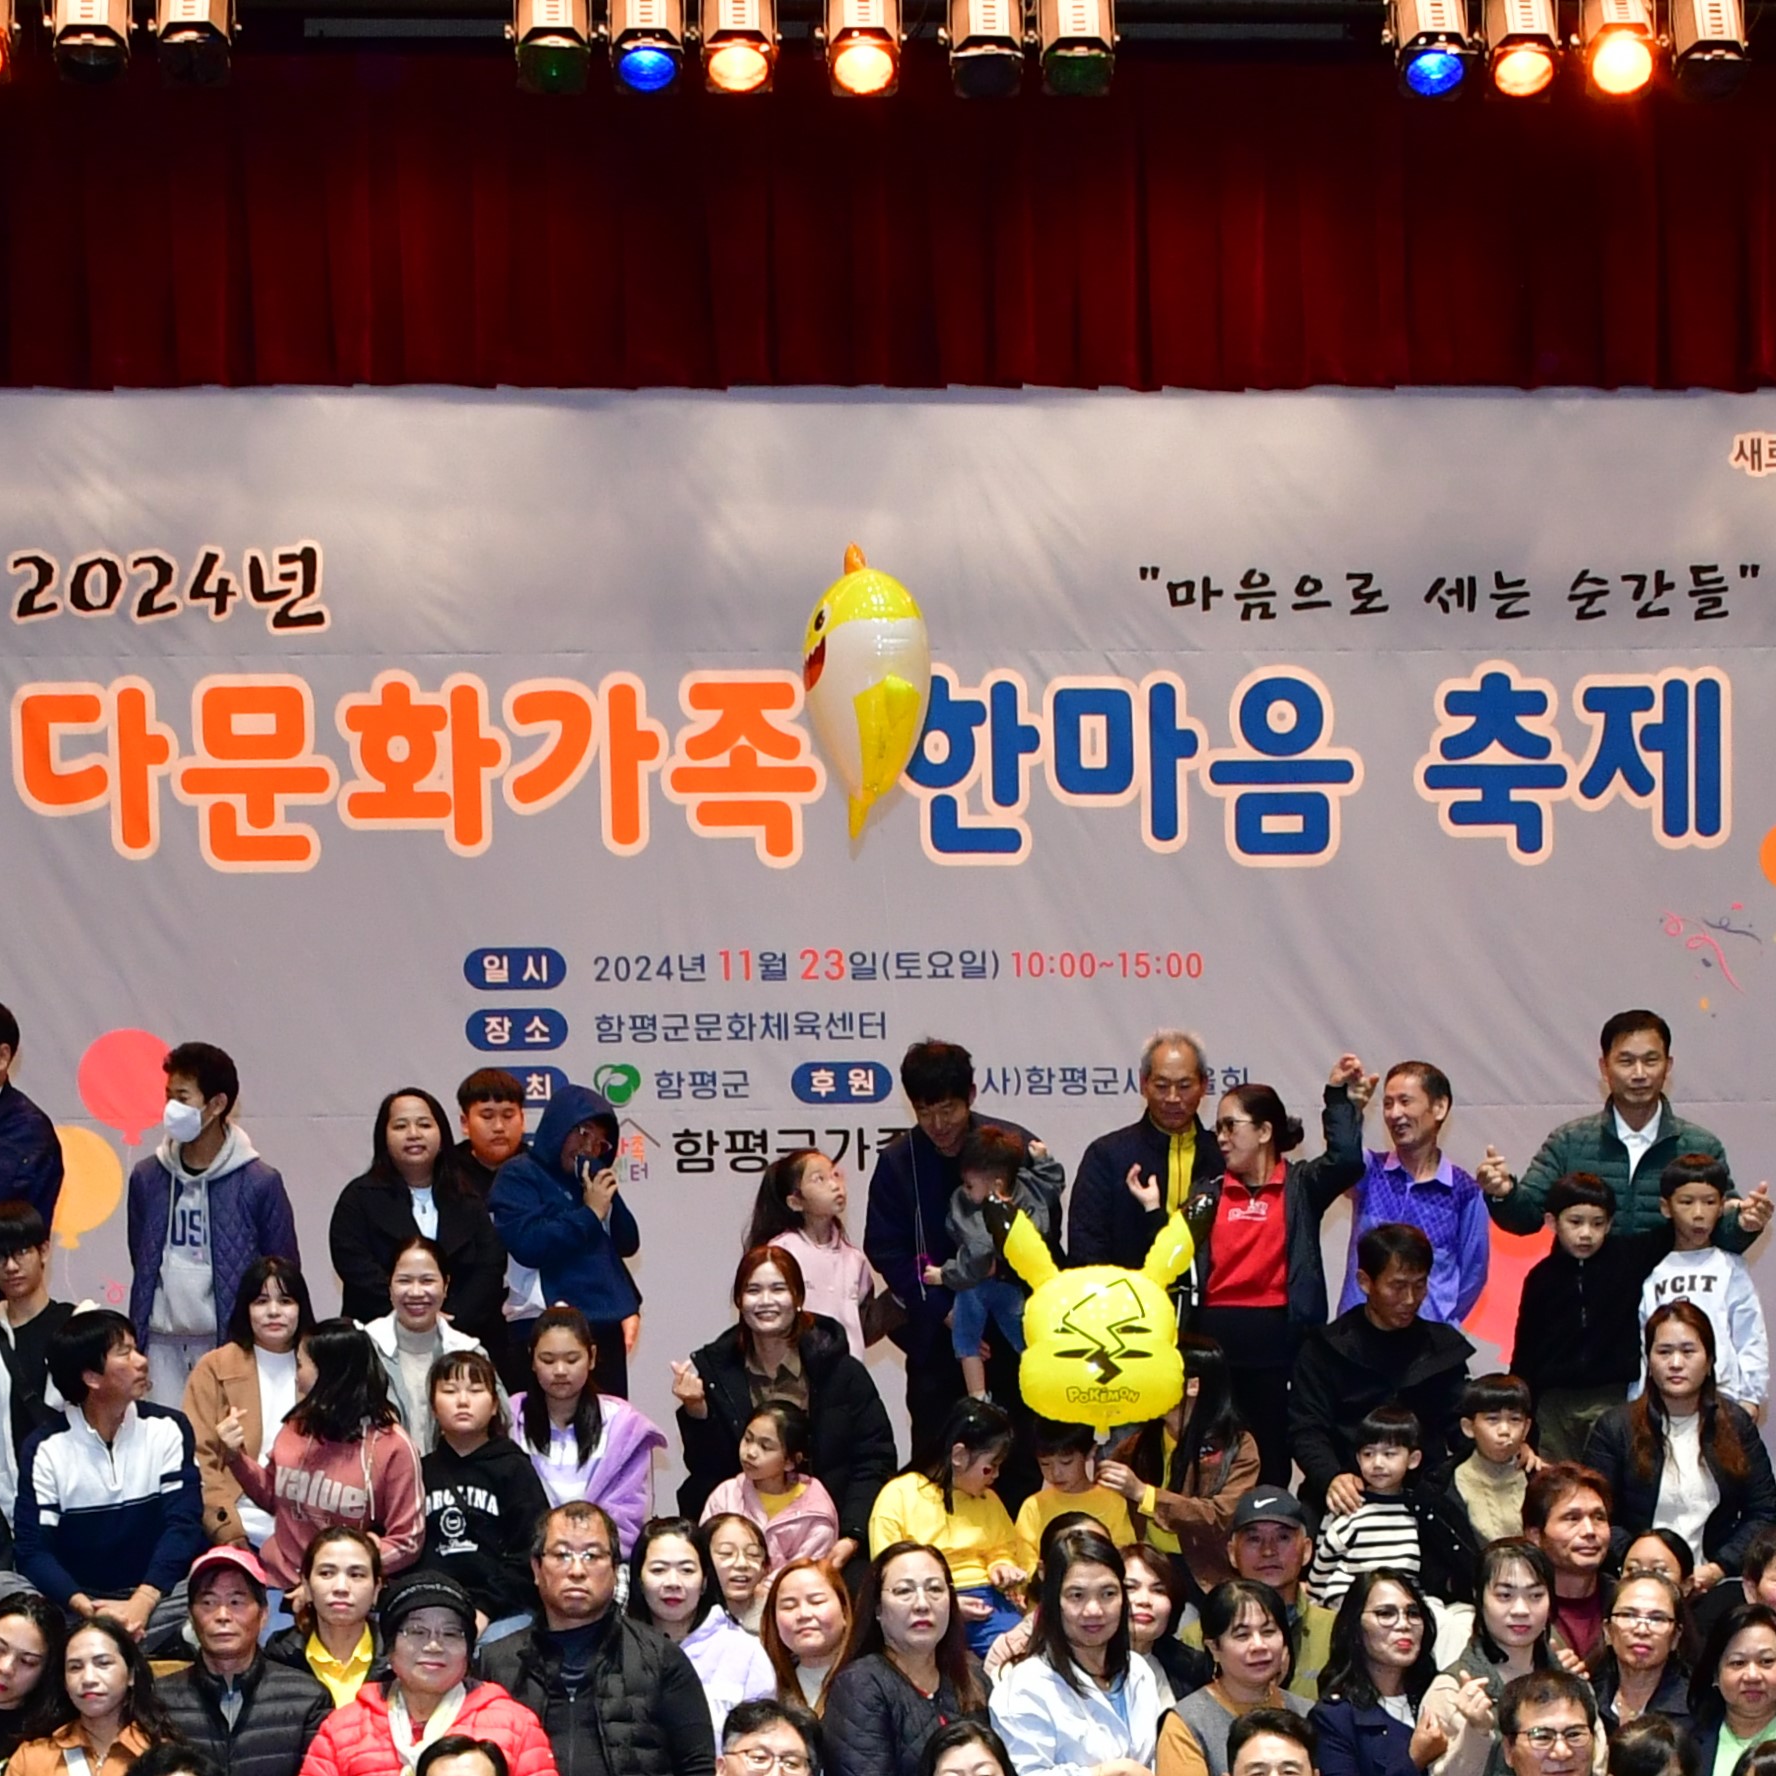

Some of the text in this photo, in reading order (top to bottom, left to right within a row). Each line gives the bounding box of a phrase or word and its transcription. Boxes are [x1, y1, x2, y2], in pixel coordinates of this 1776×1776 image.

[12, 546, 327, 630] 2024년
[1423, 571, 1532, 620] 세는
[20, 670, 1724, 863] 다문화가족 한마음 축제
[593, 953, 707, 983] 2024년
[718, 948, 788, 982] 11월
[799, 947, 1000, 983] 23일(토요일)
[1011, 950, 1204, 980] 10:00~15:00
[595, 1009, 888, 1043] 함평군문화체육센터
[653, 1069, 750, 1101] 함평군
[275, 1465, 367, 1519] value
